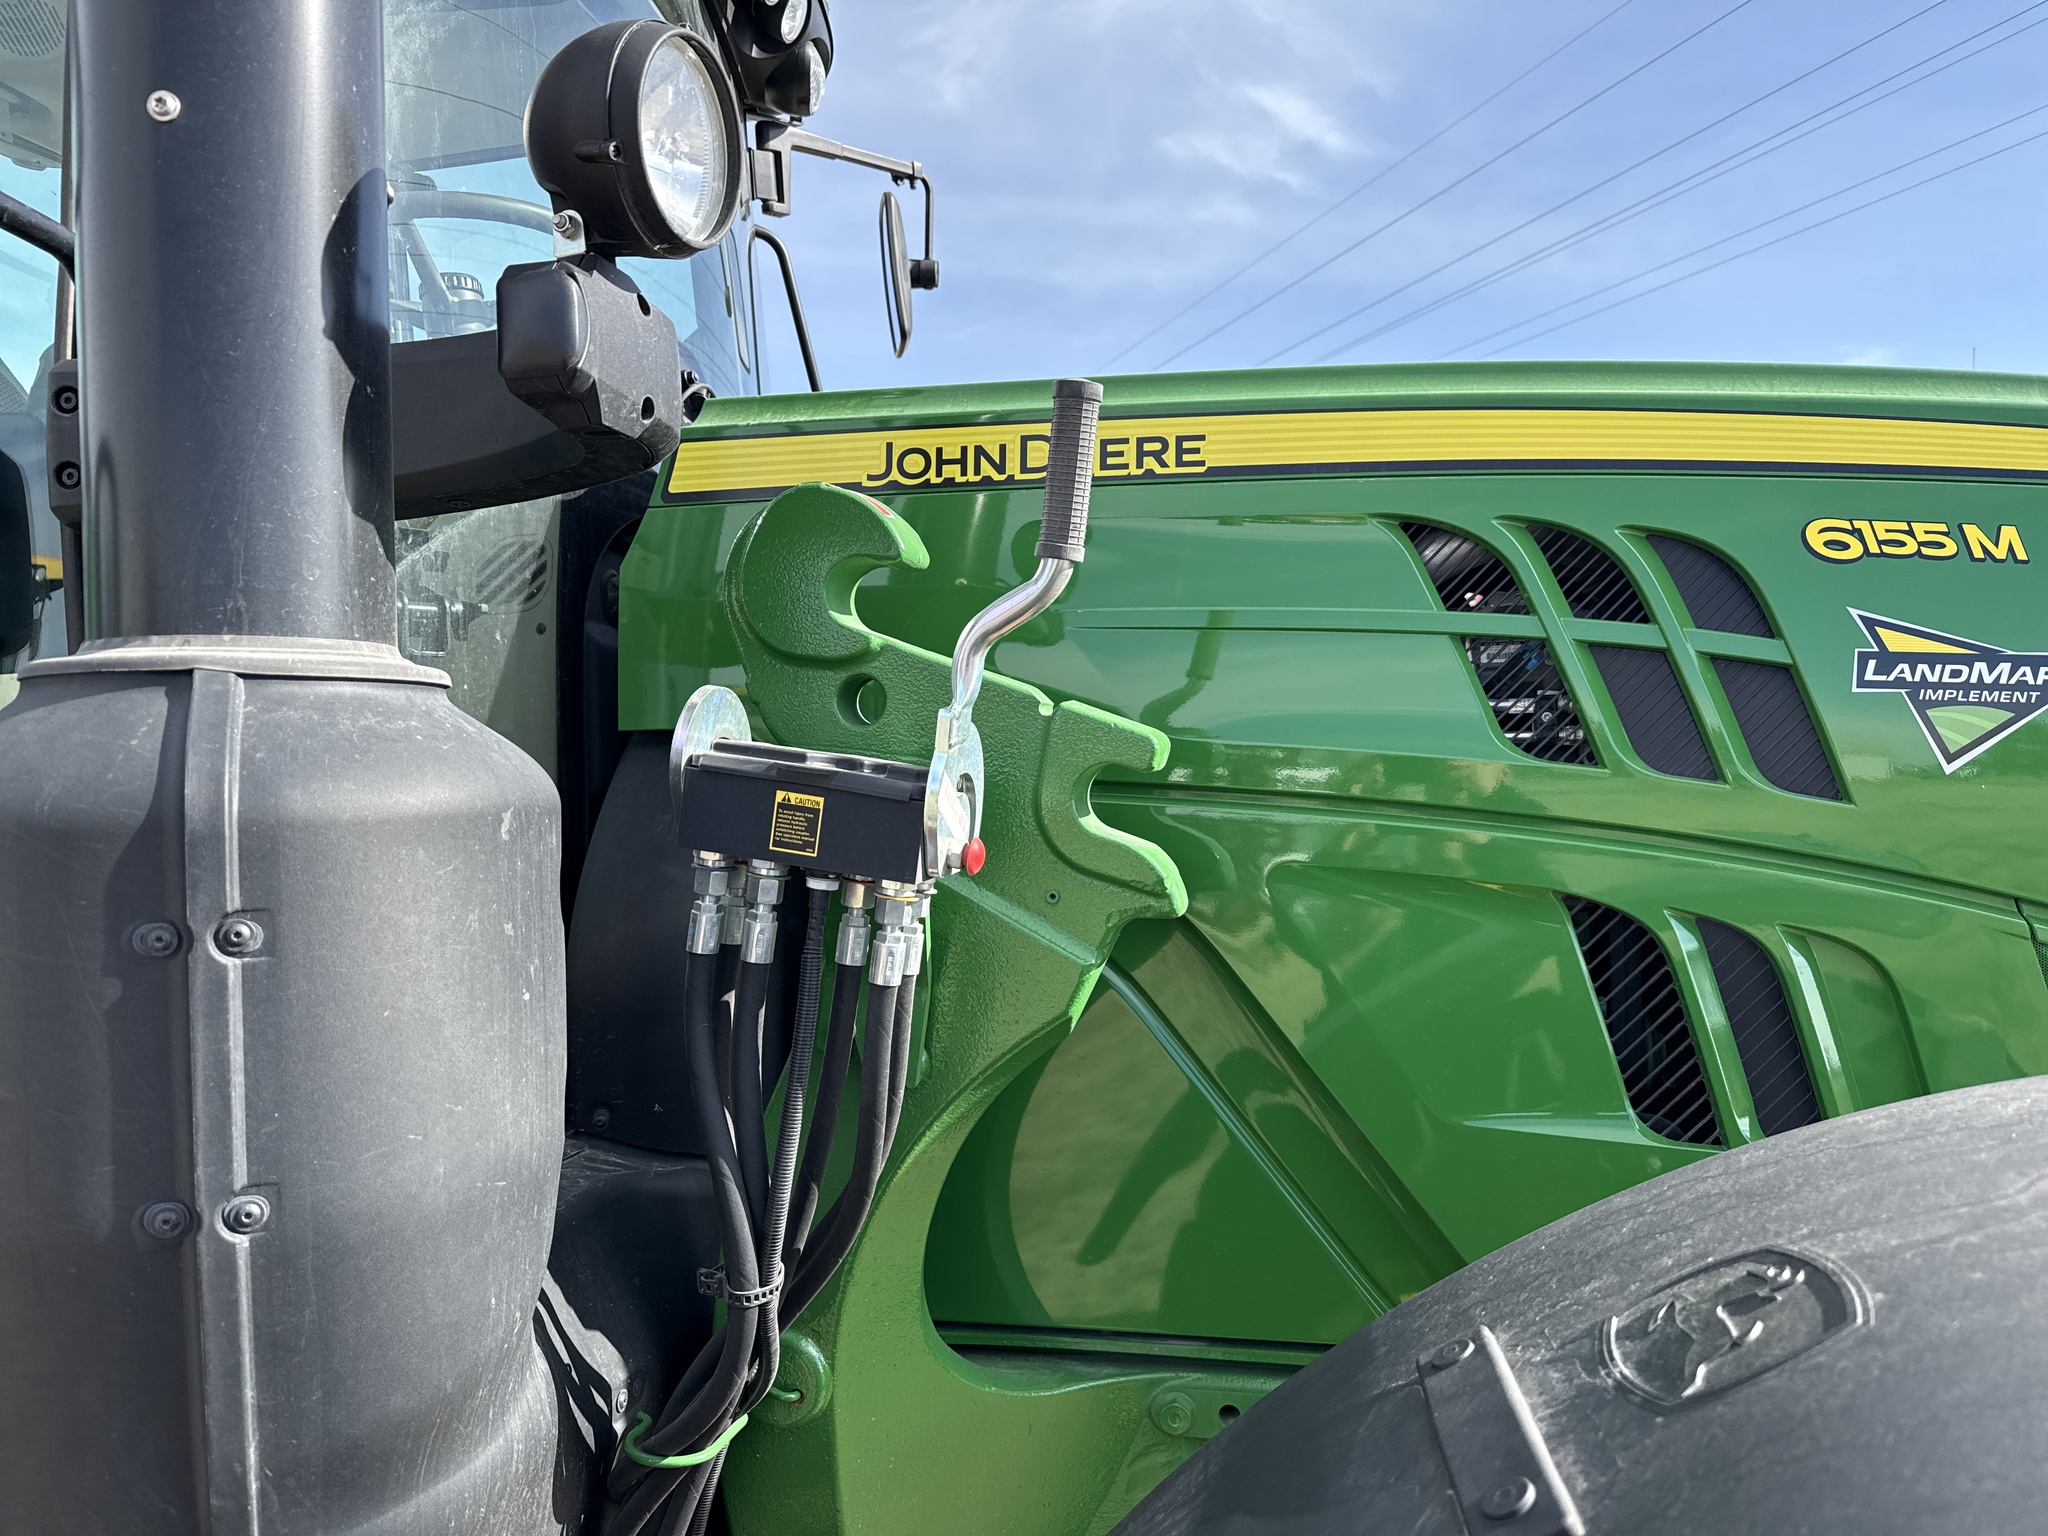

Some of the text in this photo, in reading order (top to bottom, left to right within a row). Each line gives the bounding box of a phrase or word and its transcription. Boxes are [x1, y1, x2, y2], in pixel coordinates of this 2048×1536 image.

[866, 434, 1206, 483] JOHN DERE
[1919, 689, 2041, 704] IMPLEMENT
[794, 797, 821, 807] CAUTION
